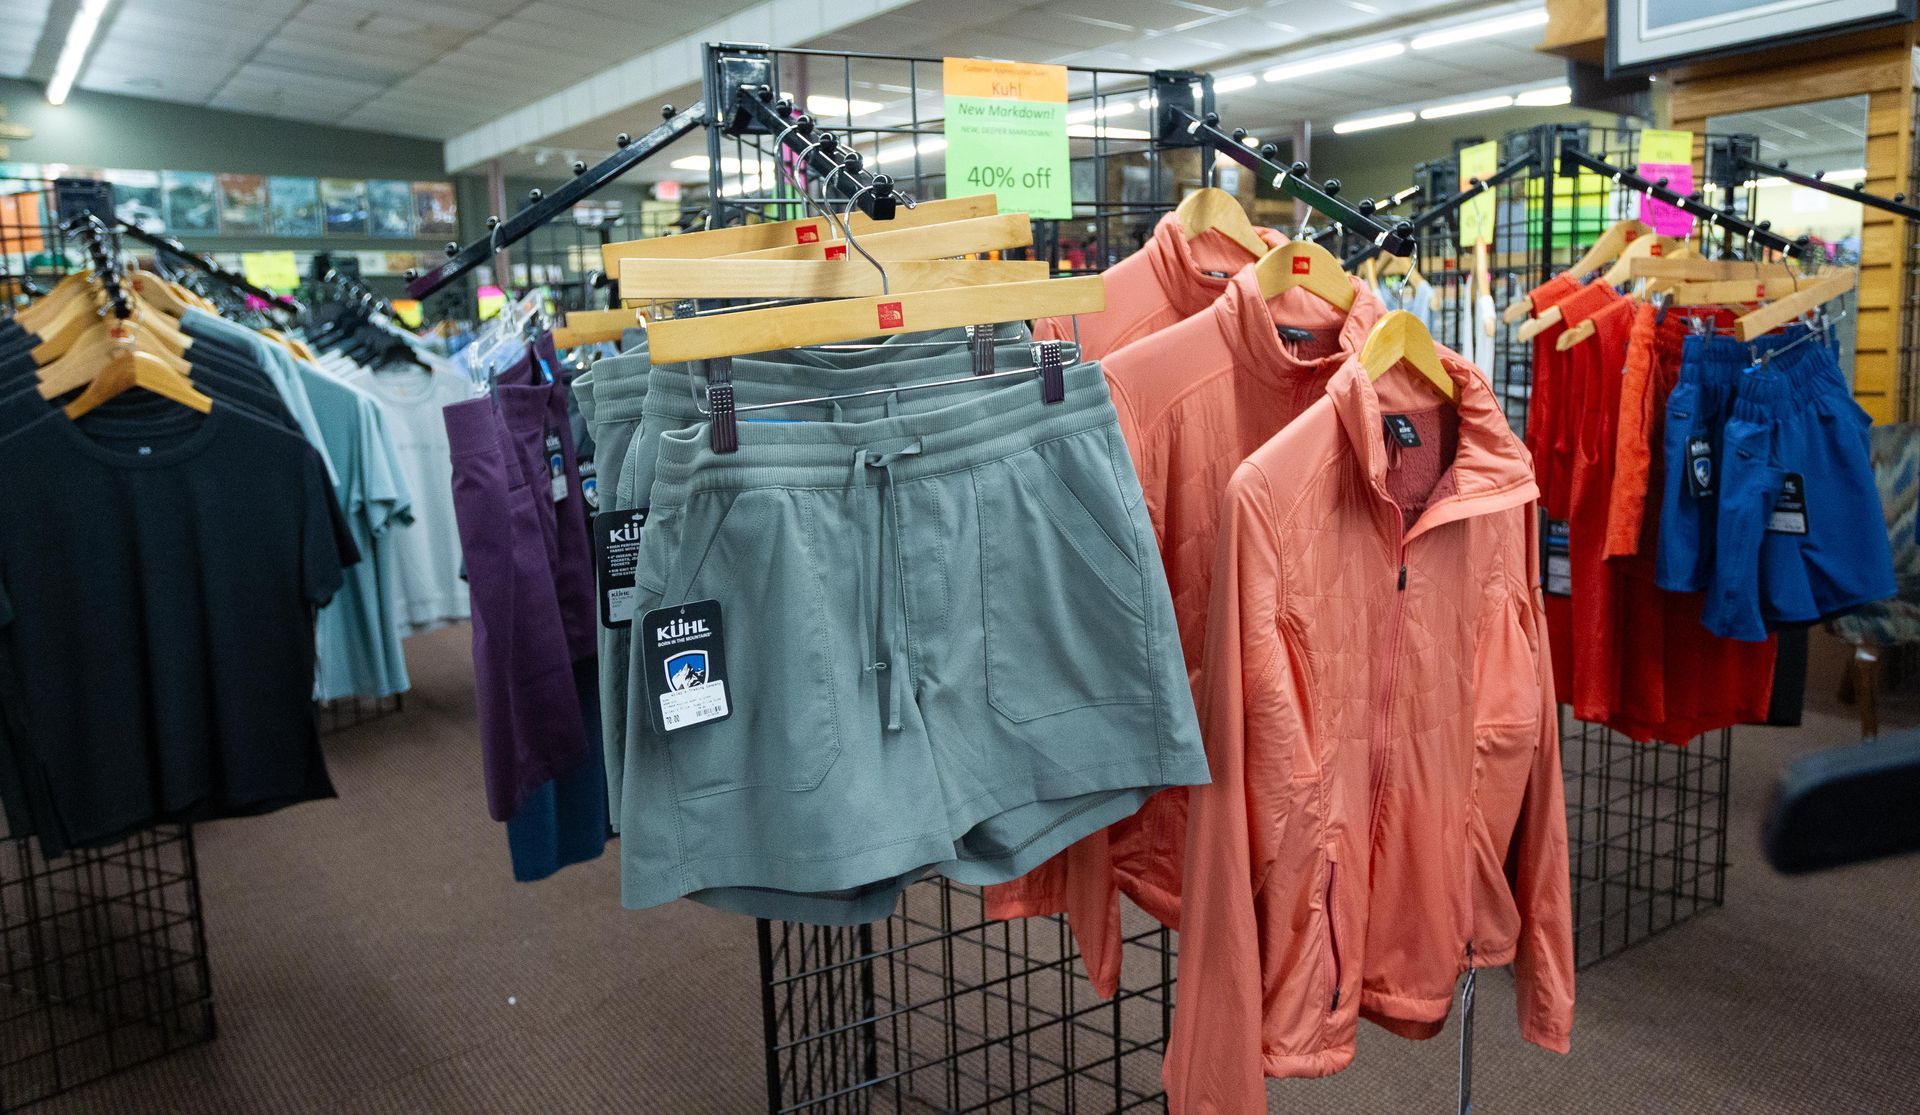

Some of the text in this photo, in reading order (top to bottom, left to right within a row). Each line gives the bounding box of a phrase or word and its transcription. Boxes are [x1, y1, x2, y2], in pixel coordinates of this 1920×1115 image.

[991, 81, 1022, 97] Kuhl
[958, 103, 1056, 120] New Markdown!
[967, 166, 1052, 189] 40% off
[657, 618, 709, 641] KÜHL
